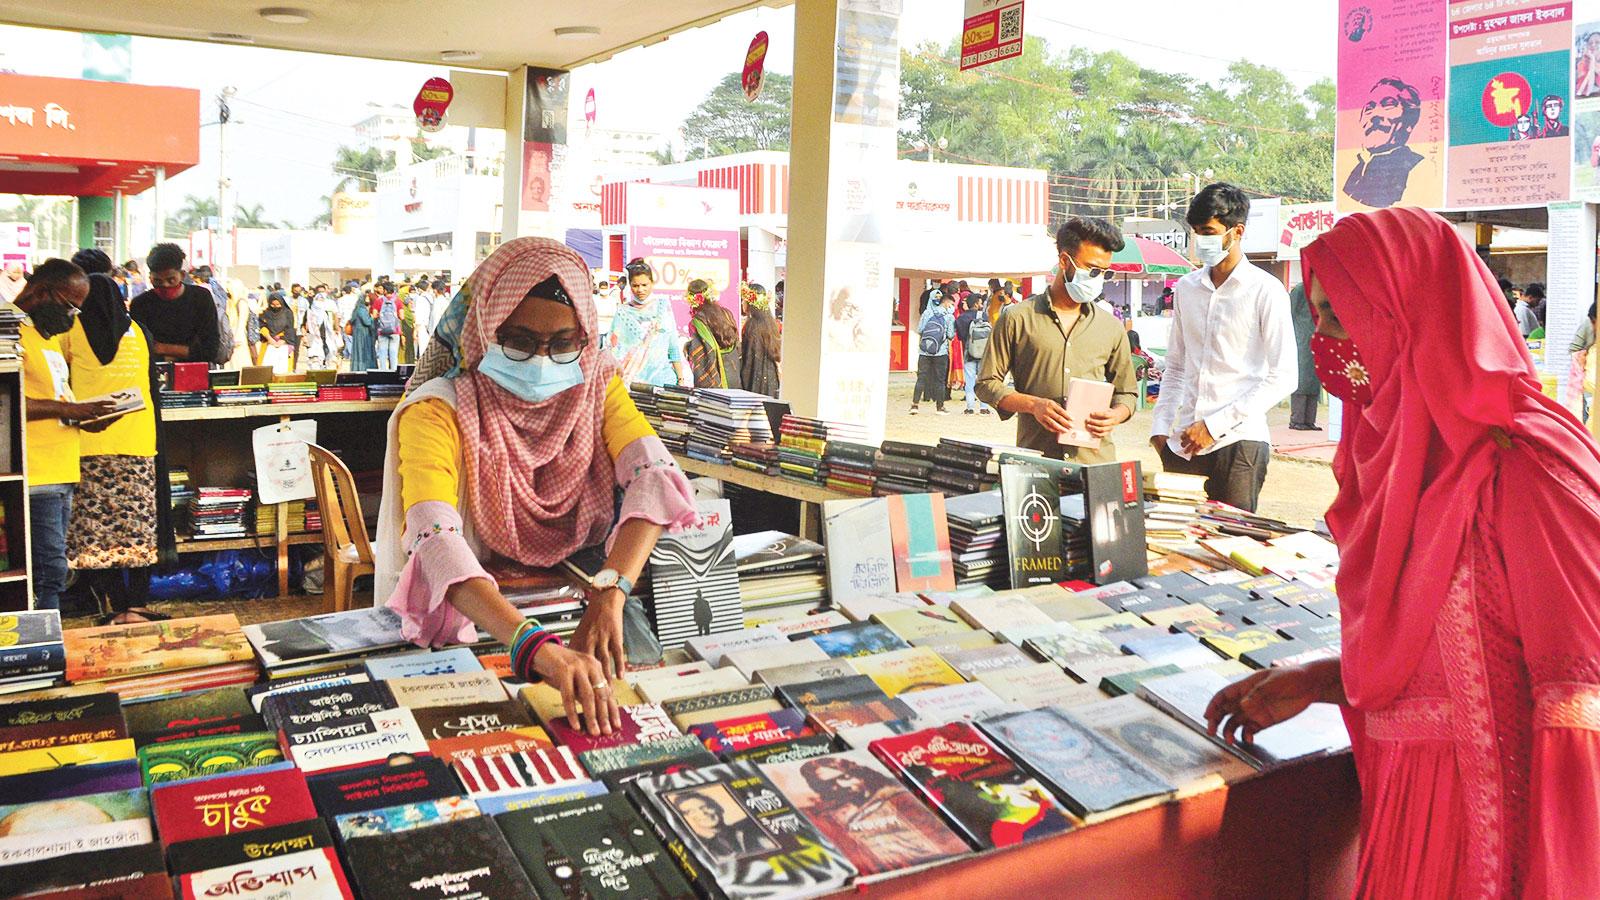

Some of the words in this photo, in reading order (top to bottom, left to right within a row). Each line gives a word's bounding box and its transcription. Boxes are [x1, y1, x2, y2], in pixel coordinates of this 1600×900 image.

[1015, 556, 1062, 572] FRAMED
[194, 794, 271, 835] চাবুক
[243, 834, 315, 859] উপেক্ষা
[204, 865, 317, 898] অভিশাপ
